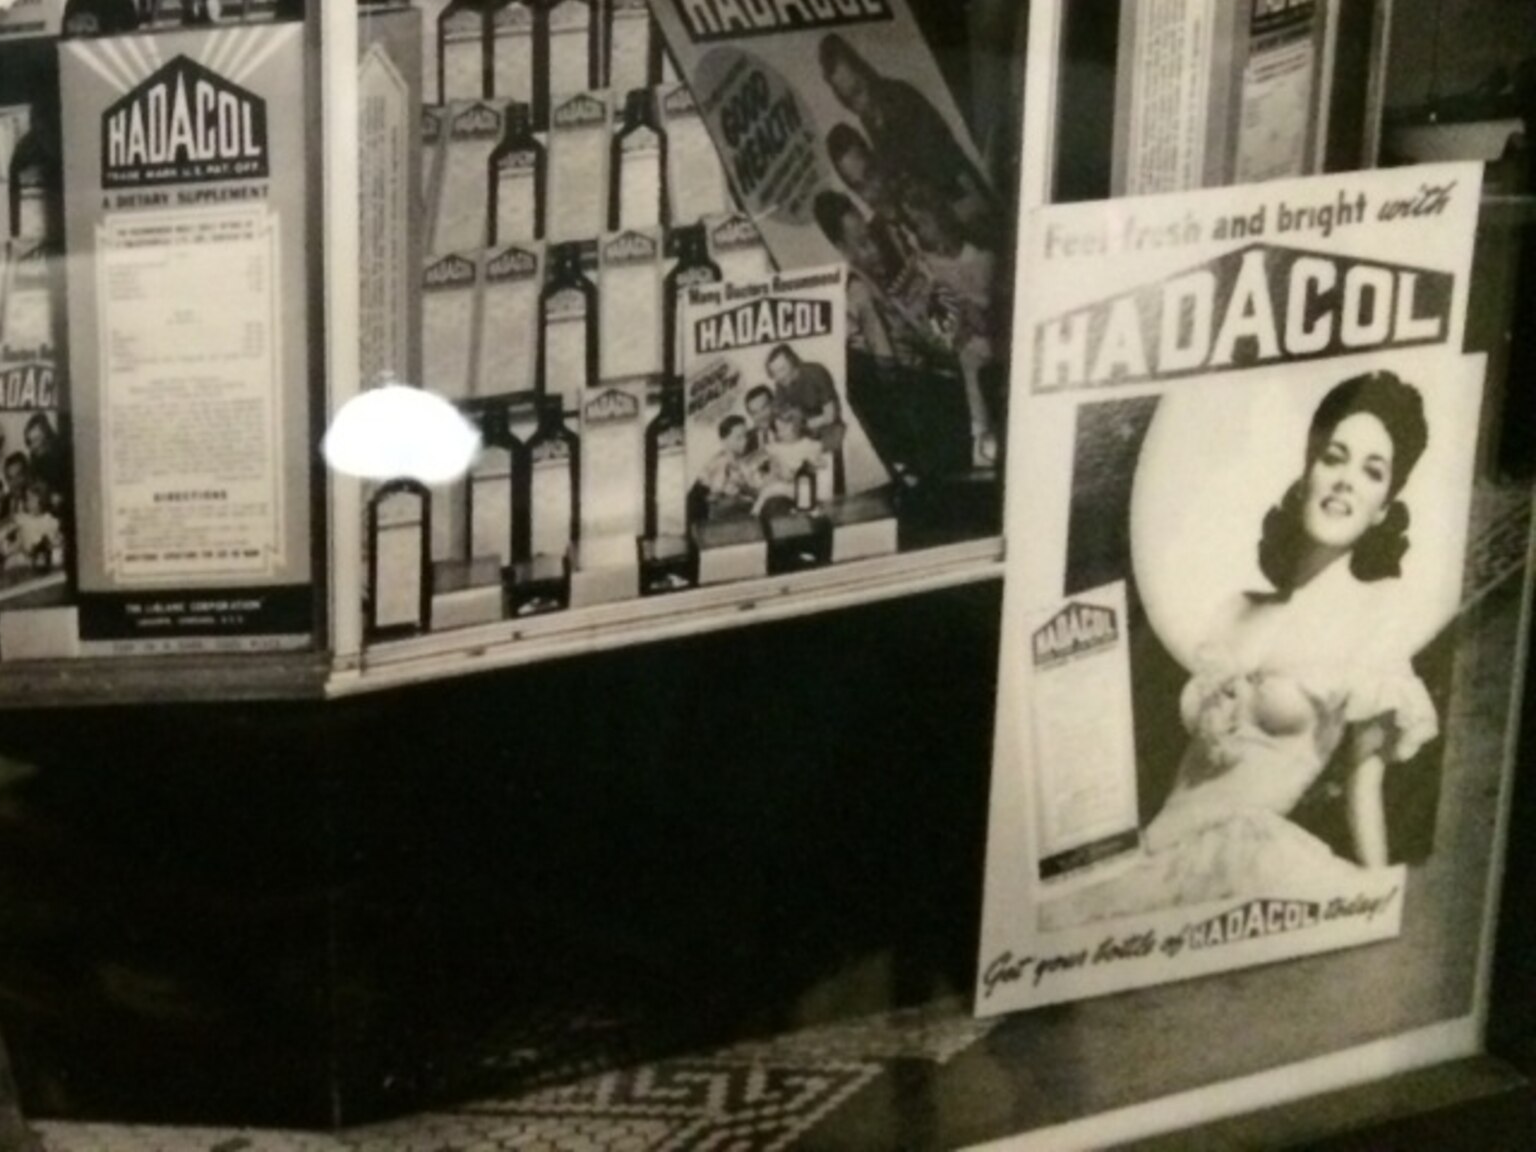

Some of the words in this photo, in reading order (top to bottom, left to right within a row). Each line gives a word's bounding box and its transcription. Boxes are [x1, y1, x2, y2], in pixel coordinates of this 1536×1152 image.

[108, 72, 261, 167] HADACOL
[176, 184, 269, 205] SUPPLEMENT
[1213, 202, 1265, 240] and
[1277, 189, 1368, 238] bright
[1376, 180, 1459, 222] with
[699, 299, 827, 352] HADACOL
[1040, 249, 1442, 386] HADACOL
[983, 951, 1033, 998] Get
[1034, 952, 1089, 987] your
[1092, 929, 1154, 966] bottle
[1189, 899, 1319, 950] HADACOL
